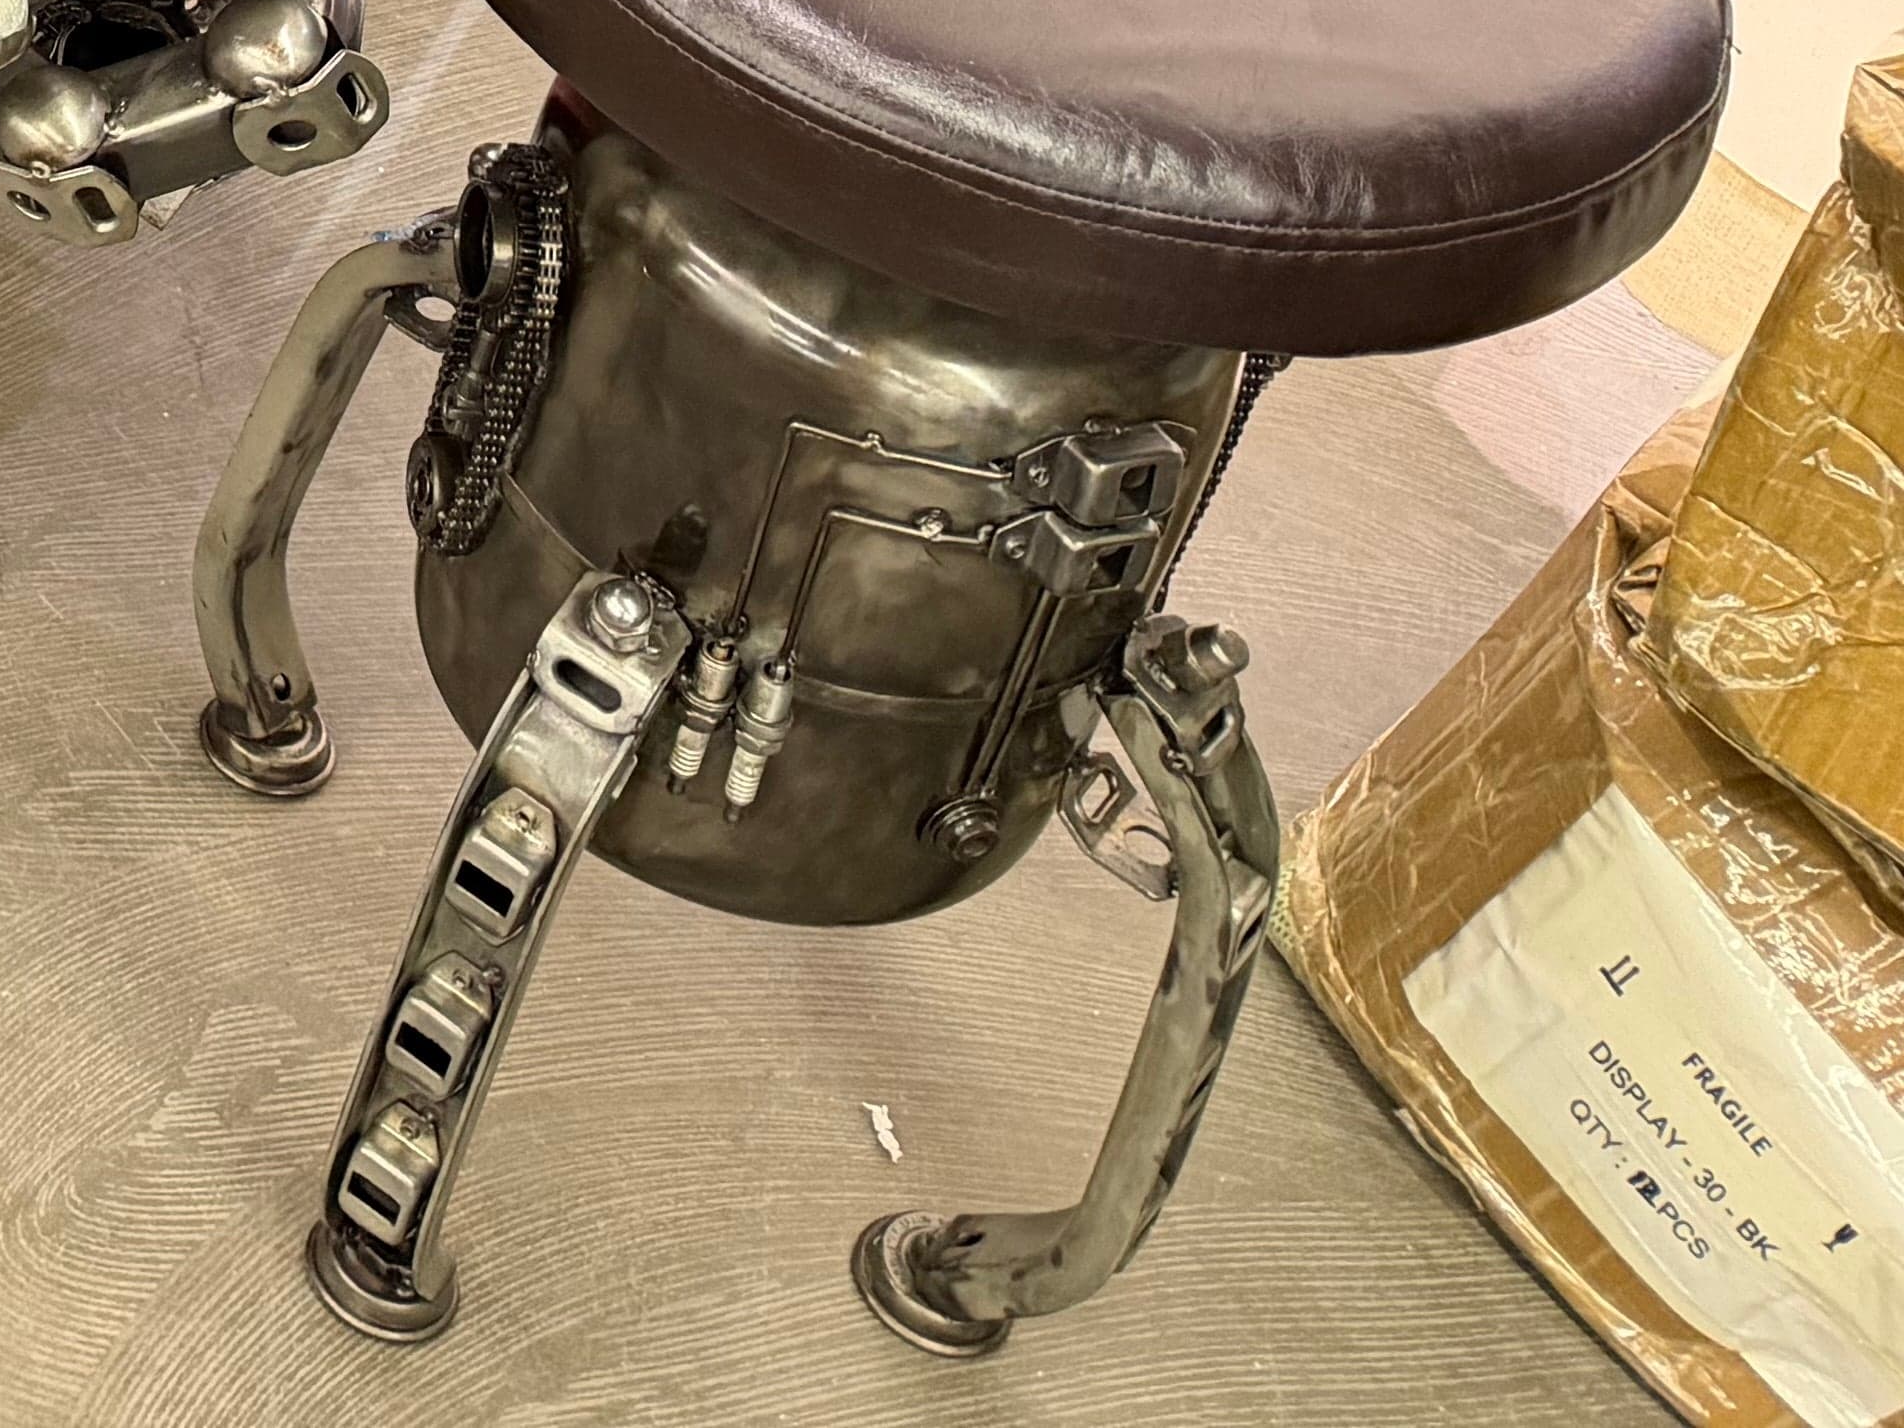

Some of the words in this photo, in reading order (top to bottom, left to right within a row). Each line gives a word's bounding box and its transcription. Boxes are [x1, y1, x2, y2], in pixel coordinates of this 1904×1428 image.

[1588, 1040, 1688, 1149] DISPLAY
[1693, 1167, 1727, 1202] 30
[1736, 1218, 1781, 1261] BK
[1681, 1052, 1773, 1157] FRAGILE
